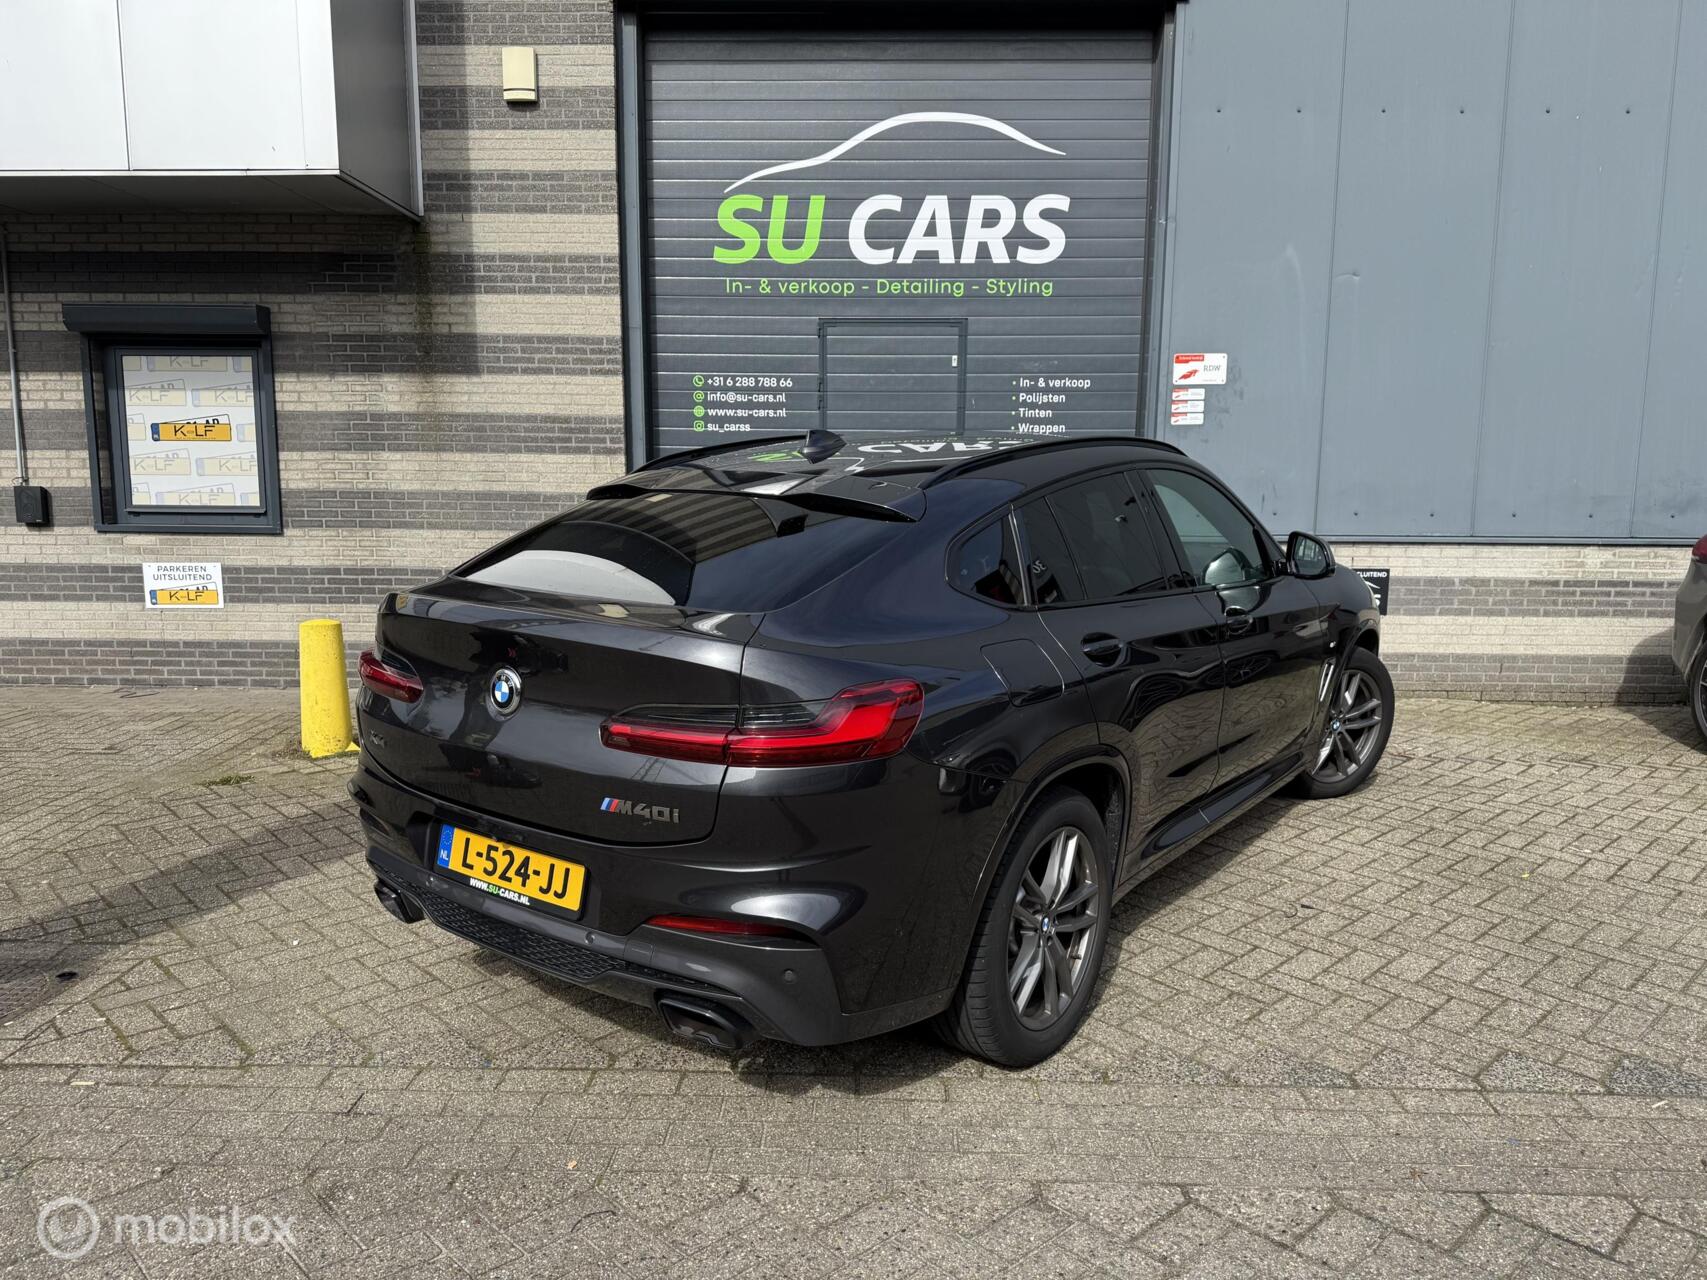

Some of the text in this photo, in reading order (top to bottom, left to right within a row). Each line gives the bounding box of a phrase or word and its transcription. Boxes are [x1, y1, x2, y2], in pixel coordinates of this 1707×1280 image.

[713, 194, 1071, 265] SU CARS
[725, 279, 752, 294] In-
[758, 279, 772, 294] &
[779, 279, 855, 298] verkoop
[877, 279, 965, 297] Detailing
[986, 279, 1054, 297] Styling
[707, 376, 793, 388] +31 6 288 788 66
[1020, 377, 1091, 389] In- & verkoop
[707, 392, 786, 403] info@su-cars.nl
[1019, 393, 1066, 404] Polijsten
[707, 408, 787, 417] www.su-cars.nl
[1018, 408, 1053, 418] Tinten
[707, 423, 751, 432] su_carss
[1018, 423, 1066, 435] Wrappen
[157, 565, 207, 573] PARKEREN
[439, 849, 449, 861] NL
[461, 837, 571, 899] L-524-JJ
[469, 877, 530, 905] WWW.SU-CARS.NL
